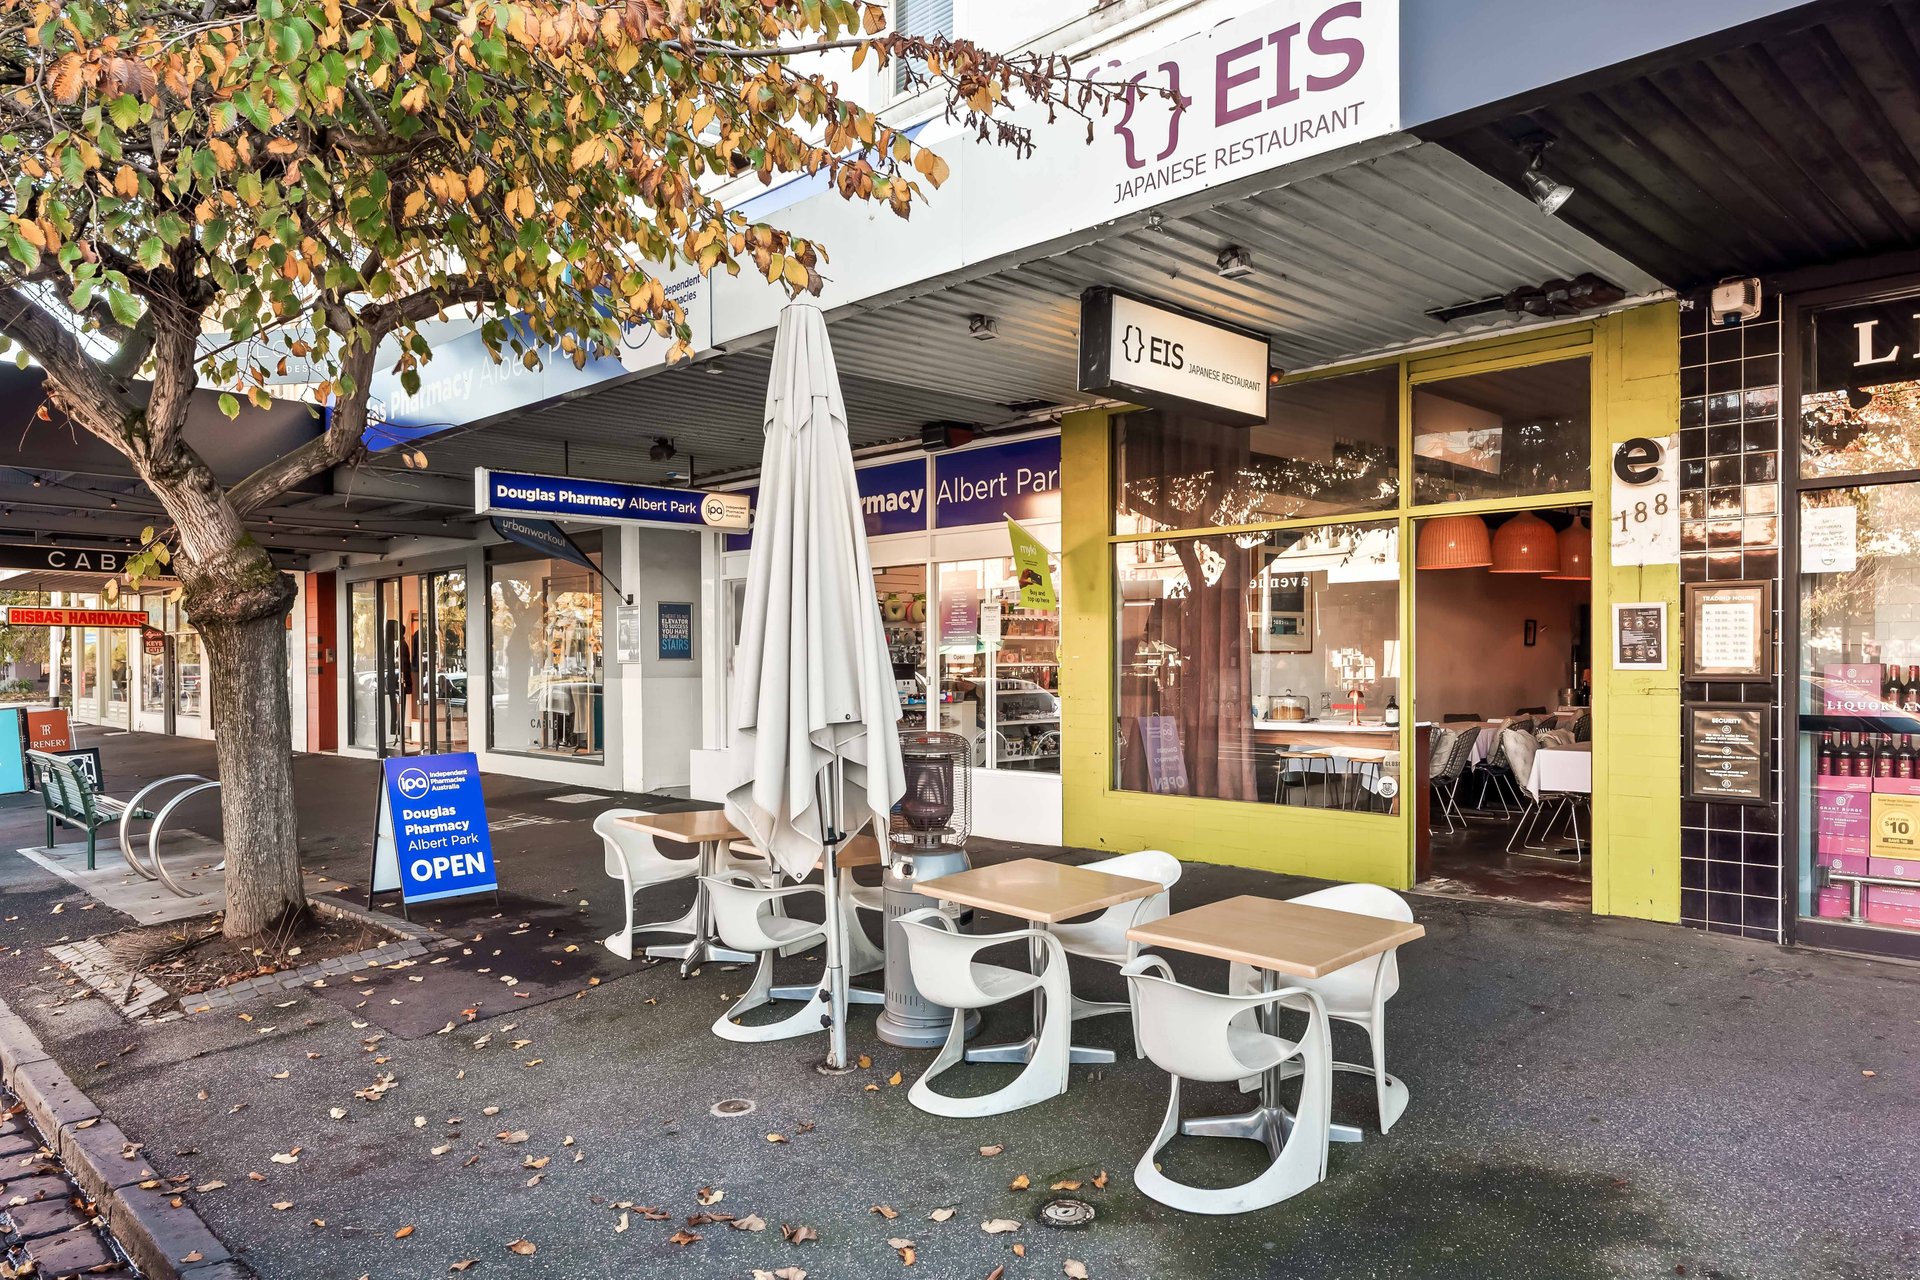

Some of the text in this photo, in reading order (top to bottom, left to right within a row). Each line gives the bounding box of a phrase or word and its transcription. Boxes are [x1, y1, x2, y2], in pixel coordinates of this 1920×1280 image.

[1215, 1, 1365, 128] EIS
[1113, 101, 1365, 203] JAPANESE RESTAURANT
[1150, 335, 1184, 370] EIS
[1188, 363, 1221, 381] JAPANESE
[1221, 372, 1261, 392] RESTAURANT
[1614, 437, 1664, 486] e
[497, 485, 697, 514] Douglas Pharmacy Albert Park
[861, 488, 924, 515] rmacy
[936, 472, 1008, 506] Albert
[707, 505, 722, 516] ipa
[1621, 493, 1668, 532] 188
[1020, 544, 1037, 557] myki
[48, 551, 117, 571] CAB
[11, 610, 146, 626] BISBAS HARDWARE
[662, 639, 689, 650] STAIRS
[33, 739, 67, 749] RENERY
[429, 768, 468, 778] Independent
[400, 775, 466, 792] ipa Pharmacies
[431, 783, 460, 792] Australia
[403, 806, 457, 821] Douglas
[405, 819, 470, 836] Pharmacy
[1884, 820, 1910, 835] $10
[408, 833, 479, 851] Albert Park
[411, 852, 486, 882] OPEN
